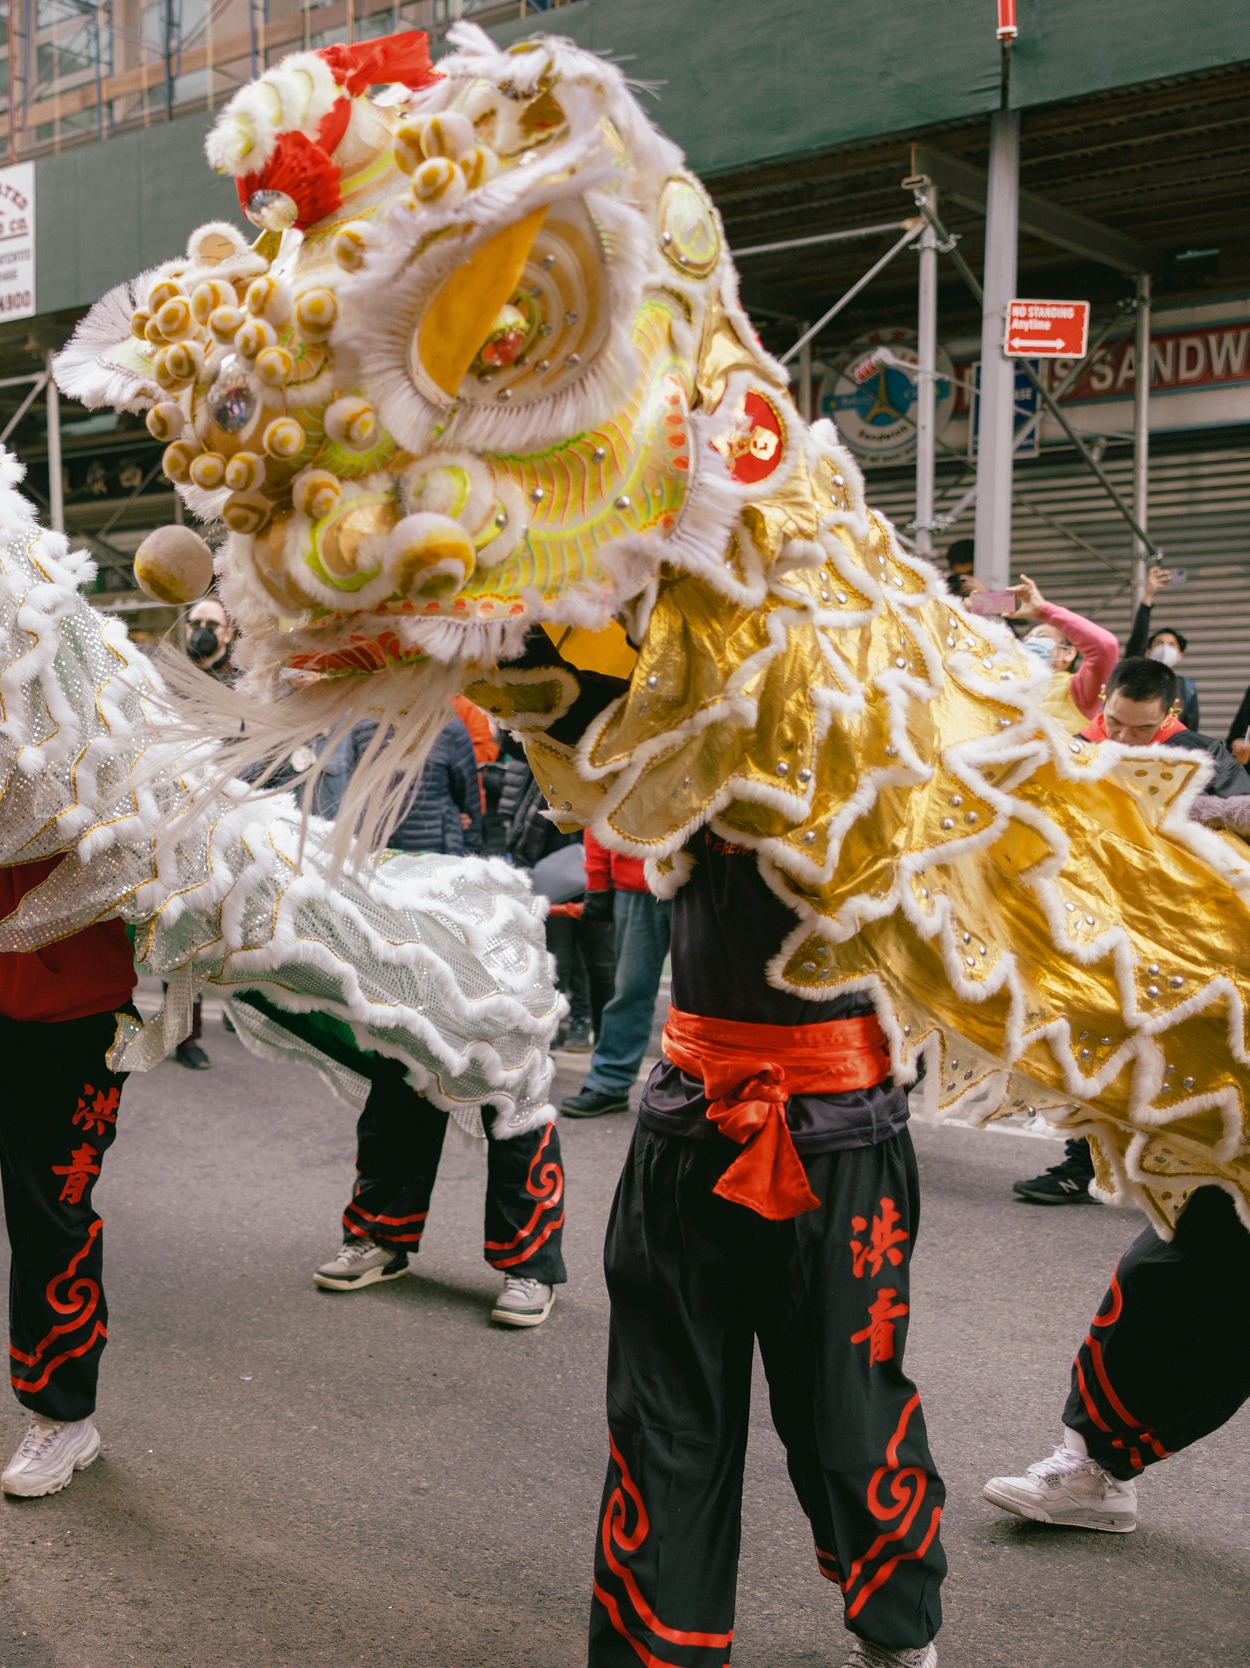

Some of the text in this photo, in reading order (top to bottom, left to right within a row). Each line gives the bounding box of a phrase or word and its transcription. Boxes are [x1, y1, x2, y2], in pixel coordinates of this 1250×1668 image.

[1012, 305, 1075, 319] NO STANDING
[1011, 318, 1052, 332] Anytime
[1089, 328, 1250, 393] SANDW
